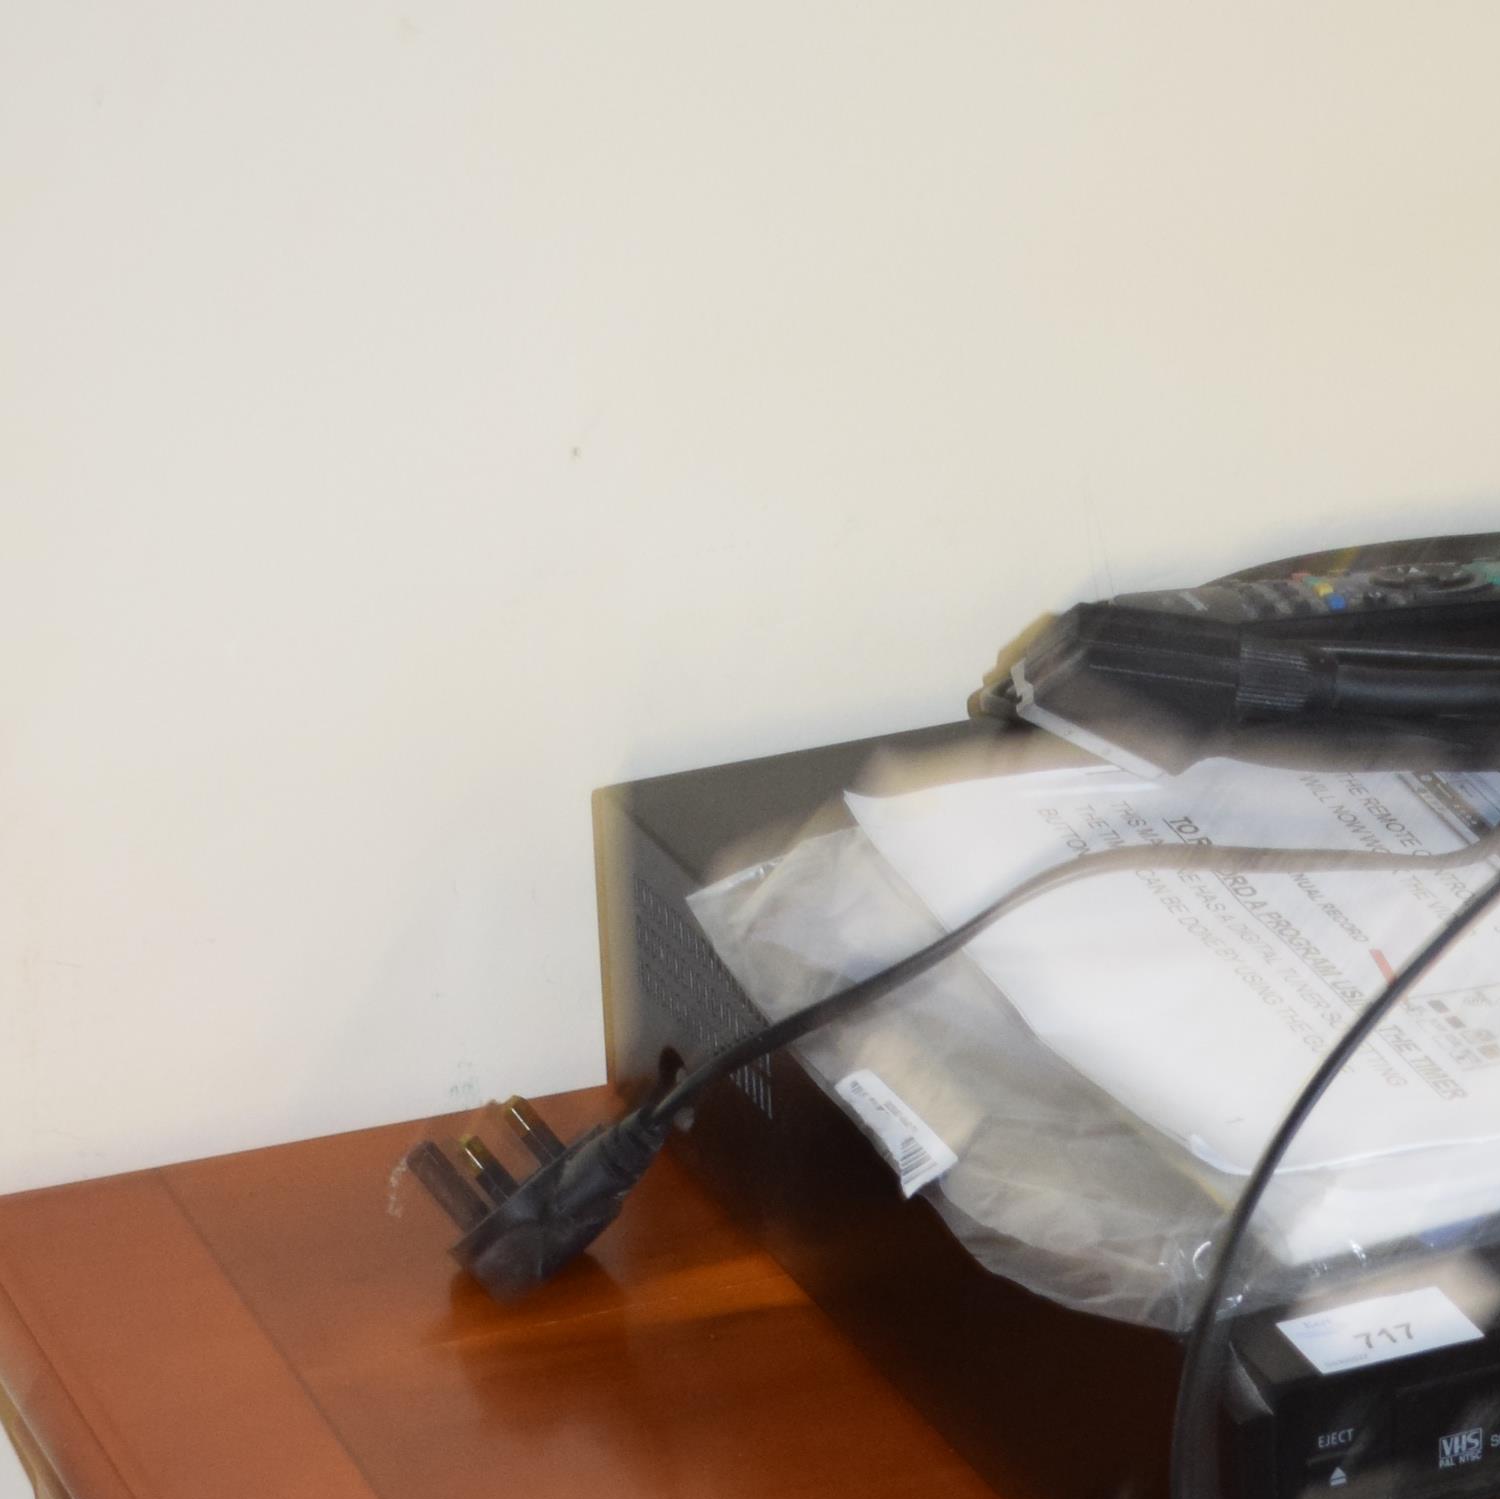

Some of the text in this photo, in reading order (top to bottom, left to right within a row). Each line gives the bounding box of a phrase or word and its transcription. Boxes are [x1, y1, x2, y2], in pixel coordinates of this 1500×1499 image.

[1108, 801, 1148, 827] THIS
[1294, 774, 1339, 802] WILL
[1326, 804, 1370, 834] NOW
[1332, 771, 1368, 795] THE
[1356, 797, 1423, 847] REMOTE
[1071, 804, 1109, 828] THE
[1155, 895, 1194, 914] BE
[1230, 966, 1286, 1005] USING
[1315, 902, 1372, 942] RECORD
[1165, 816, 1204, 834] TO
[1244, 900, 1271, 910] A
[1258, 911, 1343, 976] PROGRAM
[1373, 1024, 1424, 1054] THE
[1405, 1055, 1472, 1101] TIMER
[1353, 1321, 1415, 1349] 717
[1318, 1428, 1354, 1448] EJECT
[1441, 1431, 1481, 1457] VHS
